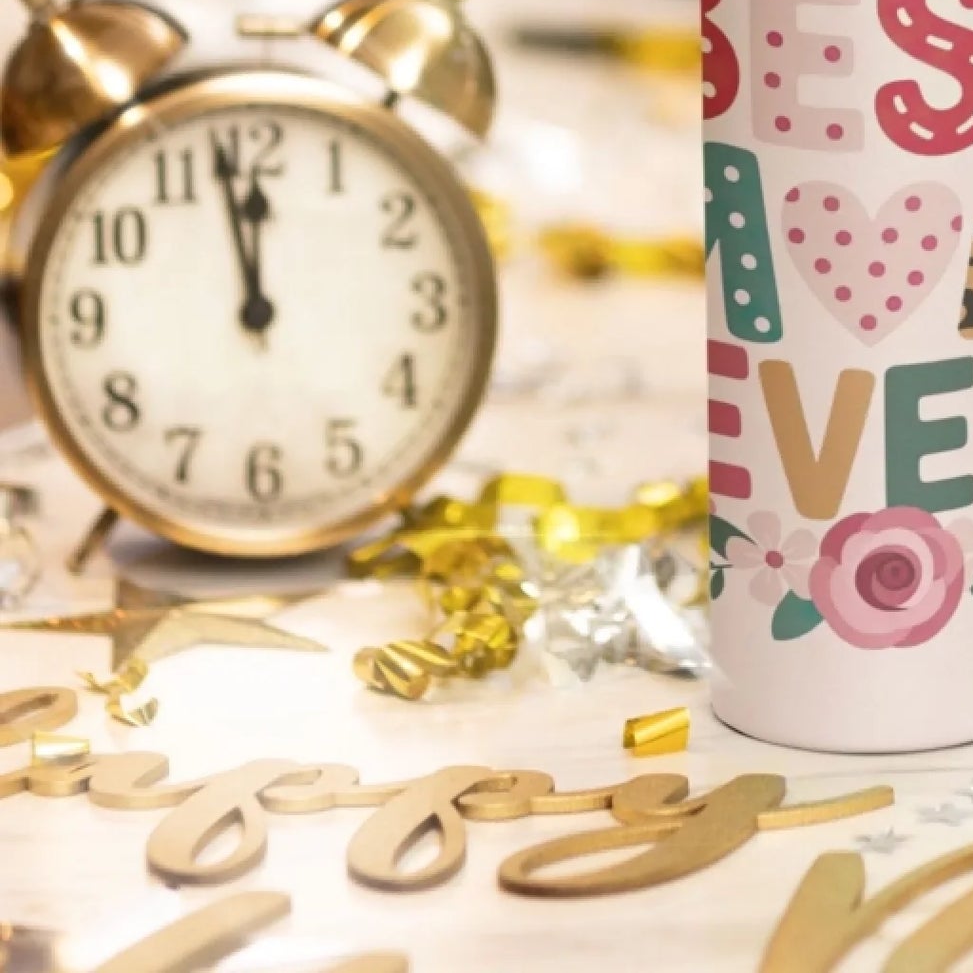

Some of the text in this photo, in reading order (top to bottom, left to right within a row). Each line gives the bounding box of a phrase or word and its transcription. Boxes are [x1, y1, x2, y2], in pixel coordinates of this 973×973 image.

[155, 146, 198, 205] 11
[326, 138, 345, 196] 1
[91, 207, 147, 266] 10
[381, 193, 417, 249] 2
[70, 289, 106, 348] 9
[411, 272, 448, 332] 3
[102, 370, 141, 432] 8
[382, 353, 416, 409] 4
[164, 426, 202, 484] 7
[245, 442, 284, 504] 6
[325, 419, 363, 479] 5
[0, 685, 894, 897] appy
